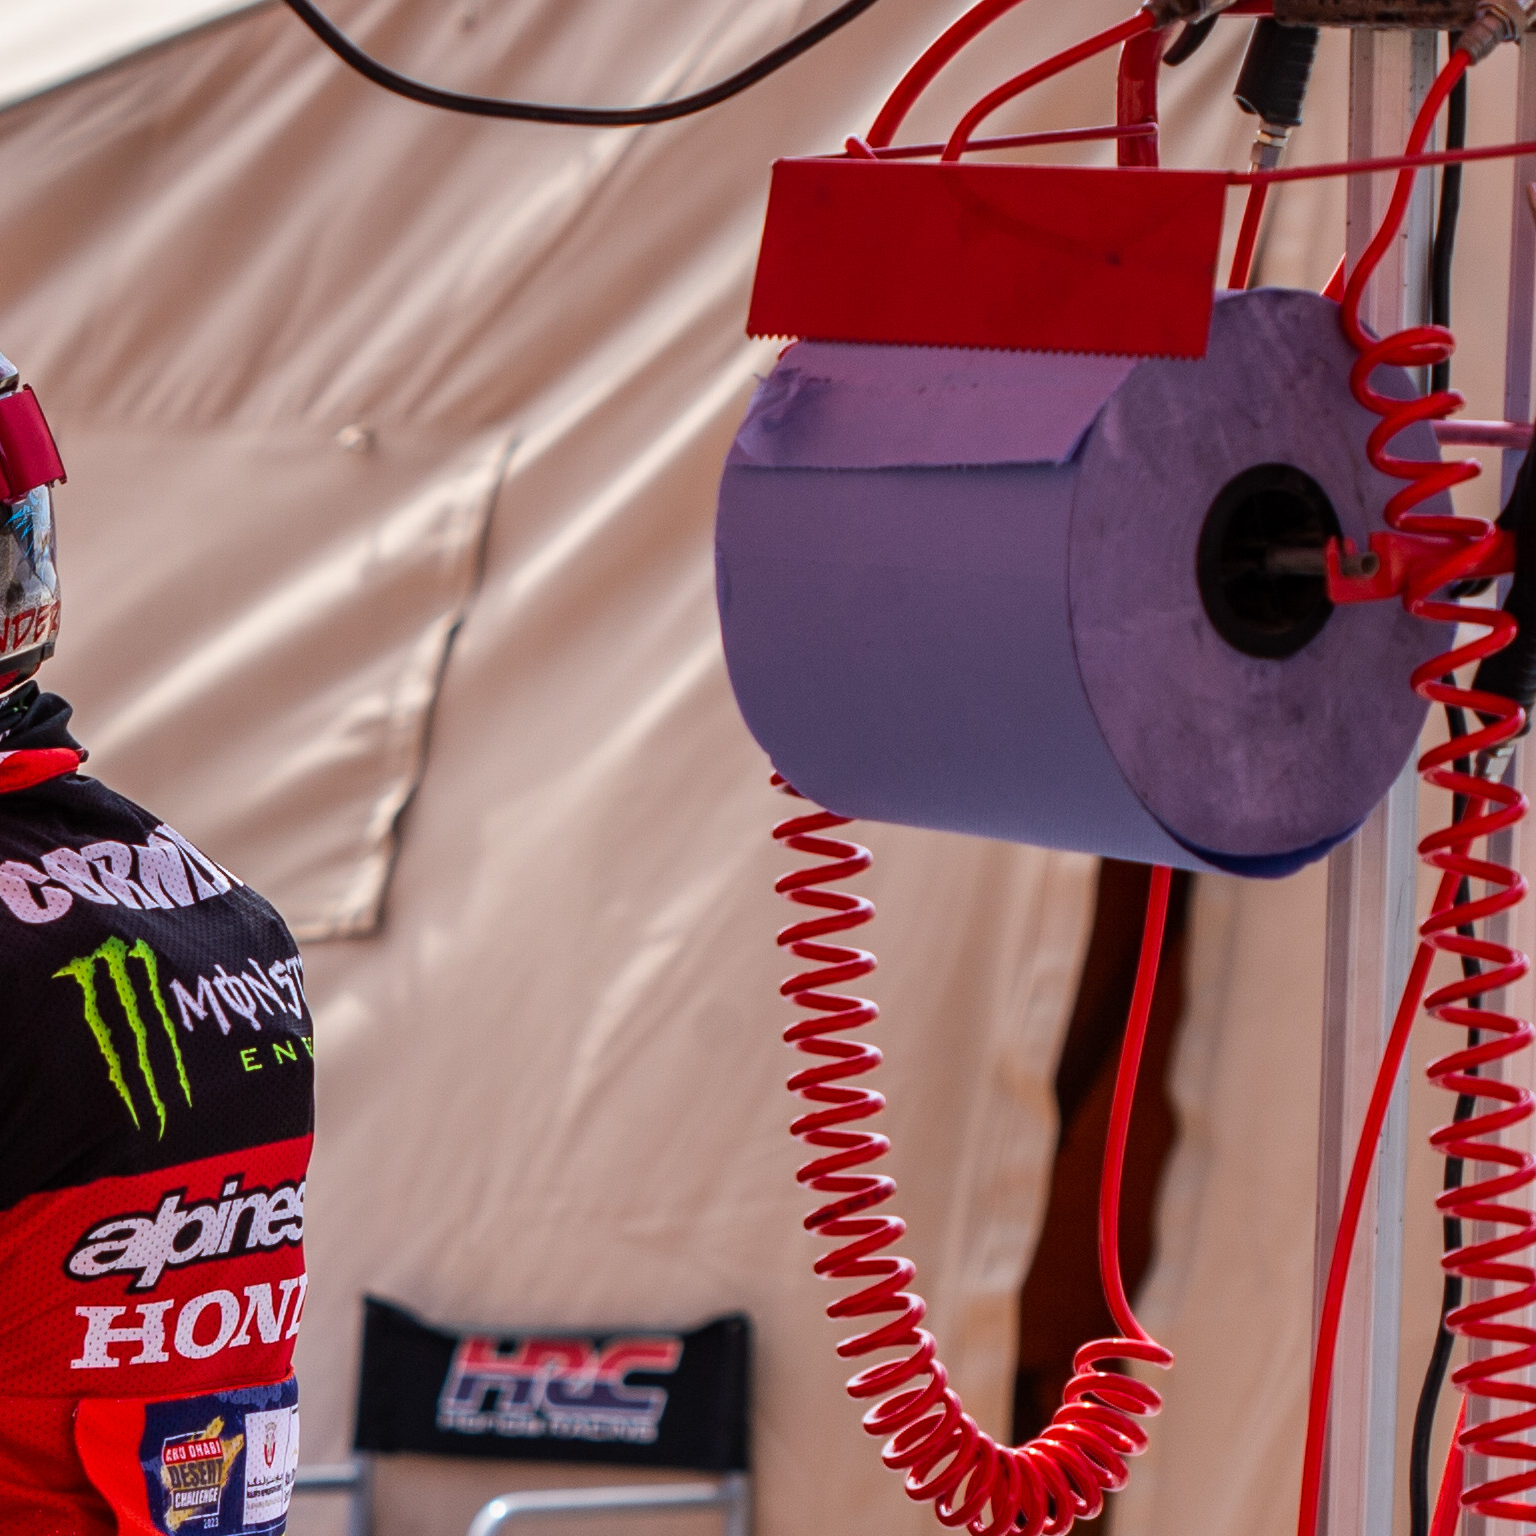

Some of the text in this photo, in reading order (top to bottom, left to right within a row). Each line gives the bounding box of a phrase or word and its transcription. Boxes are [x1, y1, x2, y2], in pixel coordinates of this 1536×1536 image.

[437, 1336, 684, 1422] HRC
[165, 1440, 222, 1463] ABU DHABI
[168, 1459, 224, 1489] DESERT
[174, 1487, 219, 1509] CHALLENGE
[203, 1516, 220, 1530] 2023
